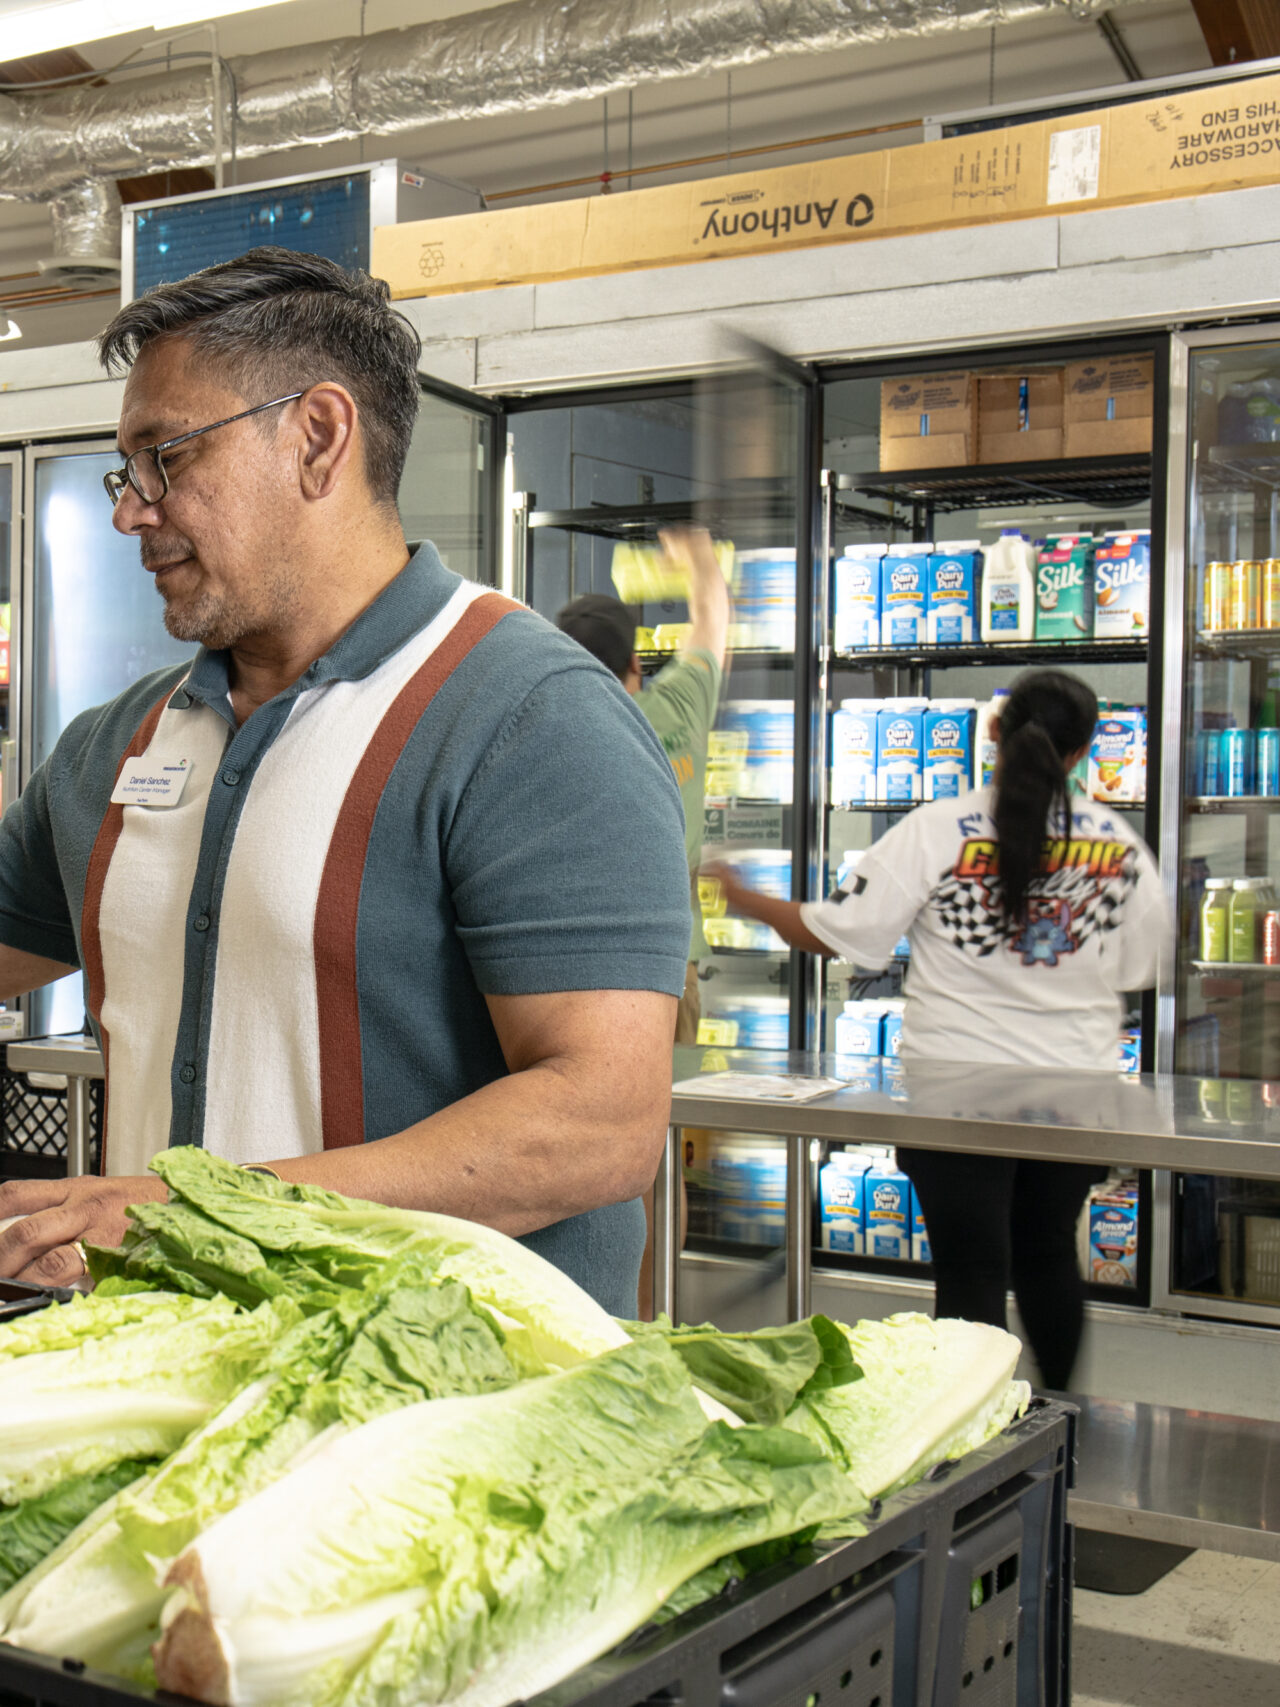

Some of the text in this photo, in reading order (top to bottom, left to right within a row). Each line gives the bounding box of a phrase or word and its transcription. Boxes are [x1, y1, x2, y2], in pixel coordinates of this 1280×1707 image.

[1245, 101, 1280, 119] HIS
[1201, 108, 1239, 127] END
[702, 198, 838, 238] Anthony
[891, 573, 919, 584] Dairy
[936, 571, 964, 583] Dairy
[1037, 562, 1085, 596] Silk
[1095, 558, 1145, 594] Silk
[893, 581, 917, 591] Pure
[938, 579, 962, 589] Pure
[1098, 608, 1130, 616] Almond
[886, 729, 914, 740] Dairy
[932, 729, 960, 740] Dairy
[1091, 731, 1133, 746] Almond
[888, 737, 912, 747] Pure
[933, 737, 958, 747] Pure
[129, 776, 171, 785] Daniel Sanchez
[873, 1190, 900, 1203] Dairy
[874, 1200, 899, 1210] Pure
[1092, 1221, 1134, 1232] Almond
